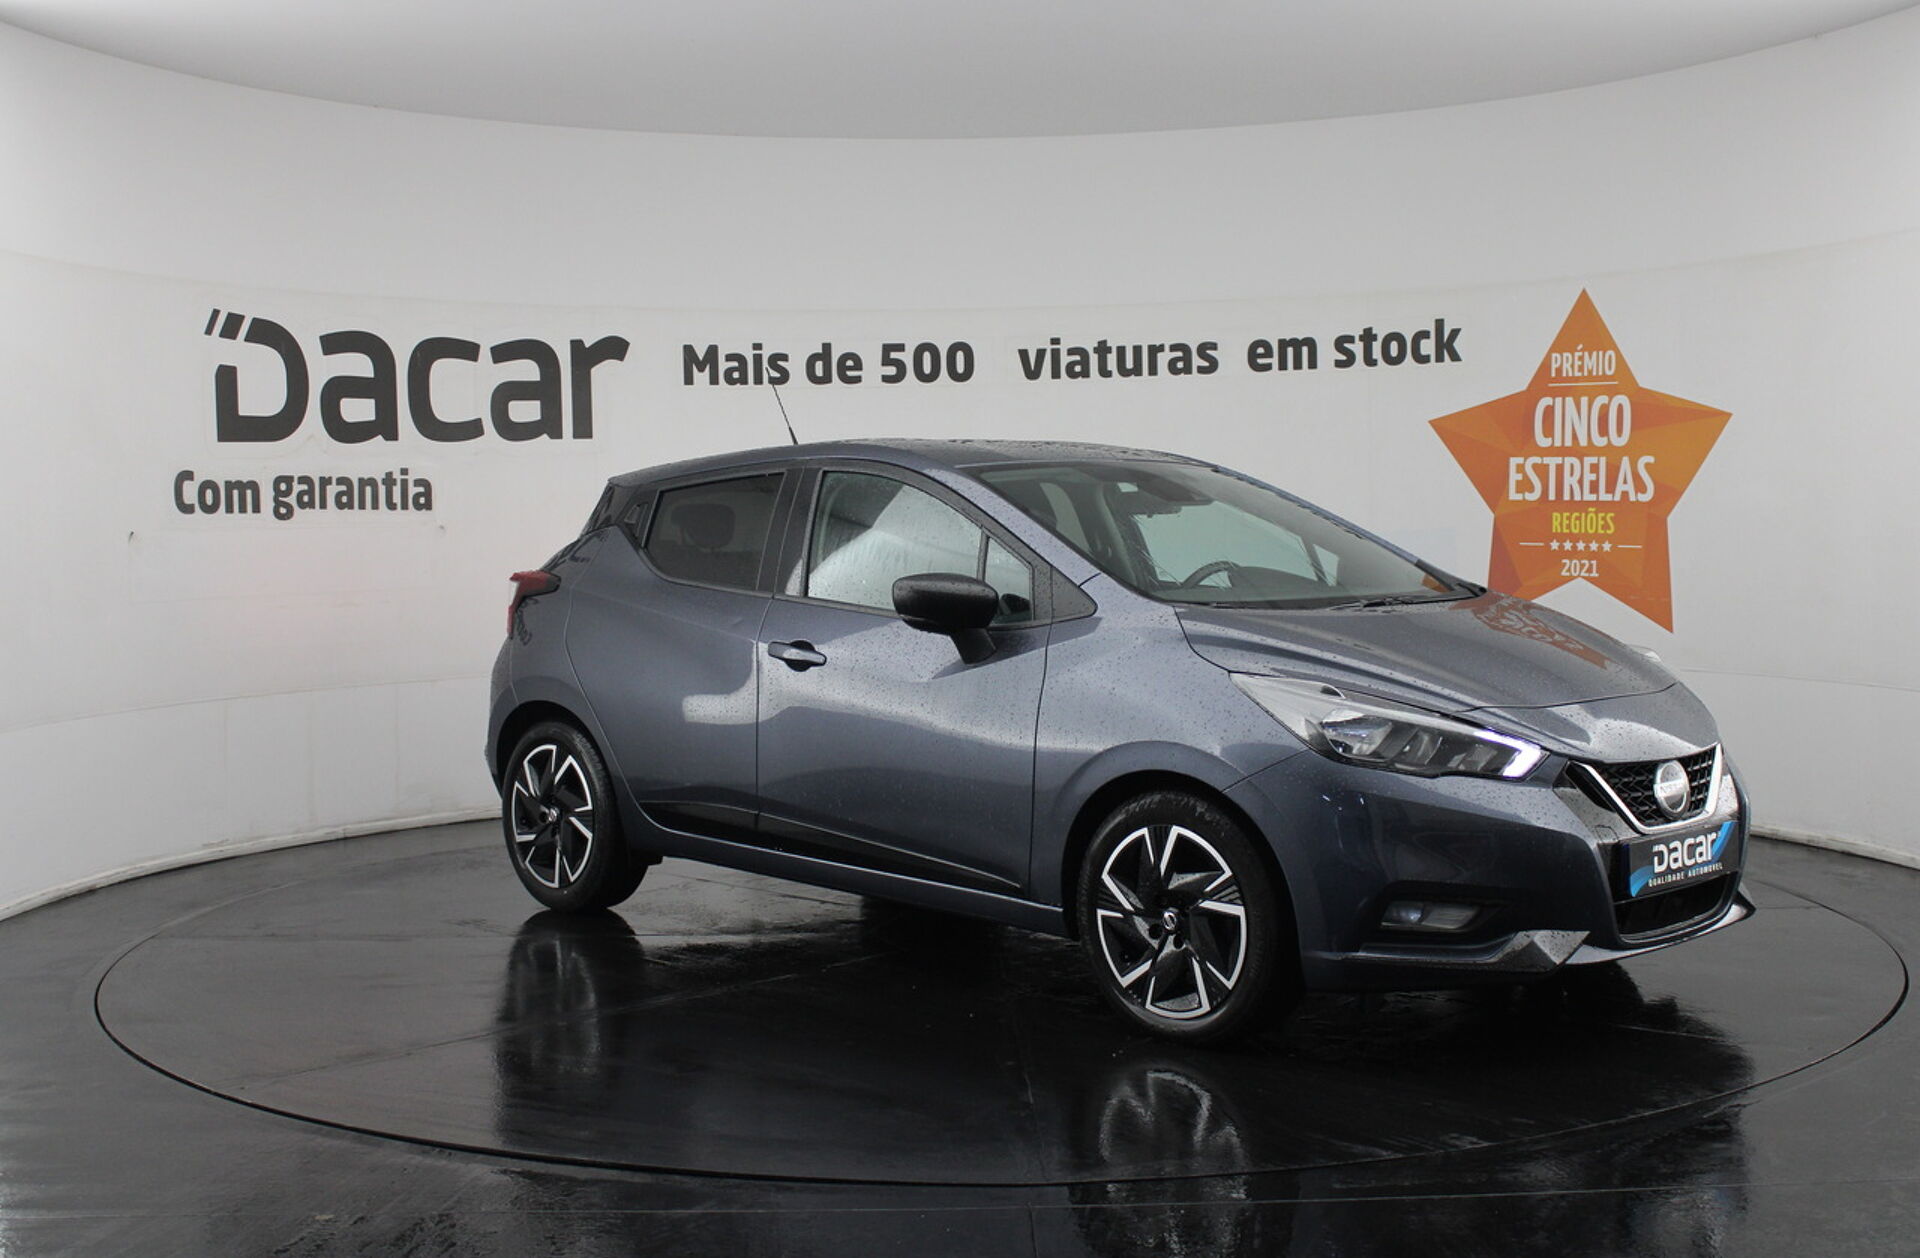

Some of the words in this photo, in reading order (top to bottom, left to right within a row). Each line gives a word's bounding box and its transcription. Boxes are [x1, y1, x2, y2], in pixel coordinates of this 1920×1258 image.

[682, 343, 790, 386] Mais
[806, 343, 864, 385] de
[881, 342, 975, 384] 500
[1017, 338, 1219, 380] viaturas
[1248, 337, 1318, 373] em
[1334, 319, 1463, 368] stock
[1550, 344, 1617, 378] PRÉMIO
[205, 309, 631, 443] Dacar
[1533, 395, 1632, 448] CINCO
[173, 470, 261, 515] Com
[272, 468, 433, 520] garantia
[1508, 456, 1656, 502] ESTRELAS
[1551, 508, 1615, 534] REGIÕES
[1560, 559, 1600, 577] 2021
[1652, 832, 1717, 873] Dacar
